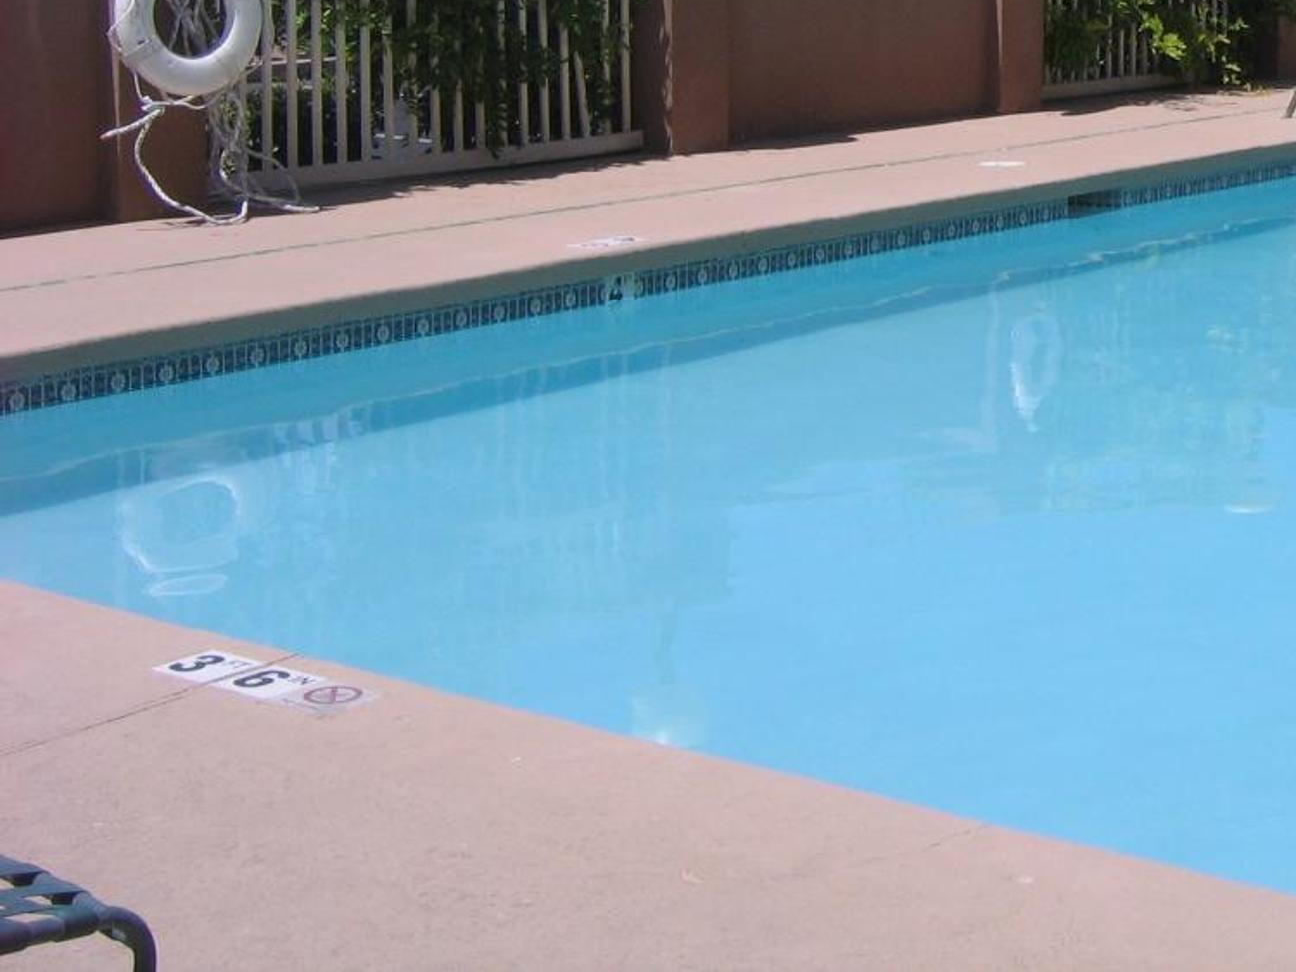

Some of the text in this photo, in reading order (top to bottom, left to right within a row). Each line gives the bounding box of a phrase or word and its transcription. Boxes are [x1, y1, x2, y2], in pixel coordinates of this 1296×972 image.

[608, 276, 623, 301] 4
[168, 654, 226, 672] 3
[233, 669, 290, 688] 6
